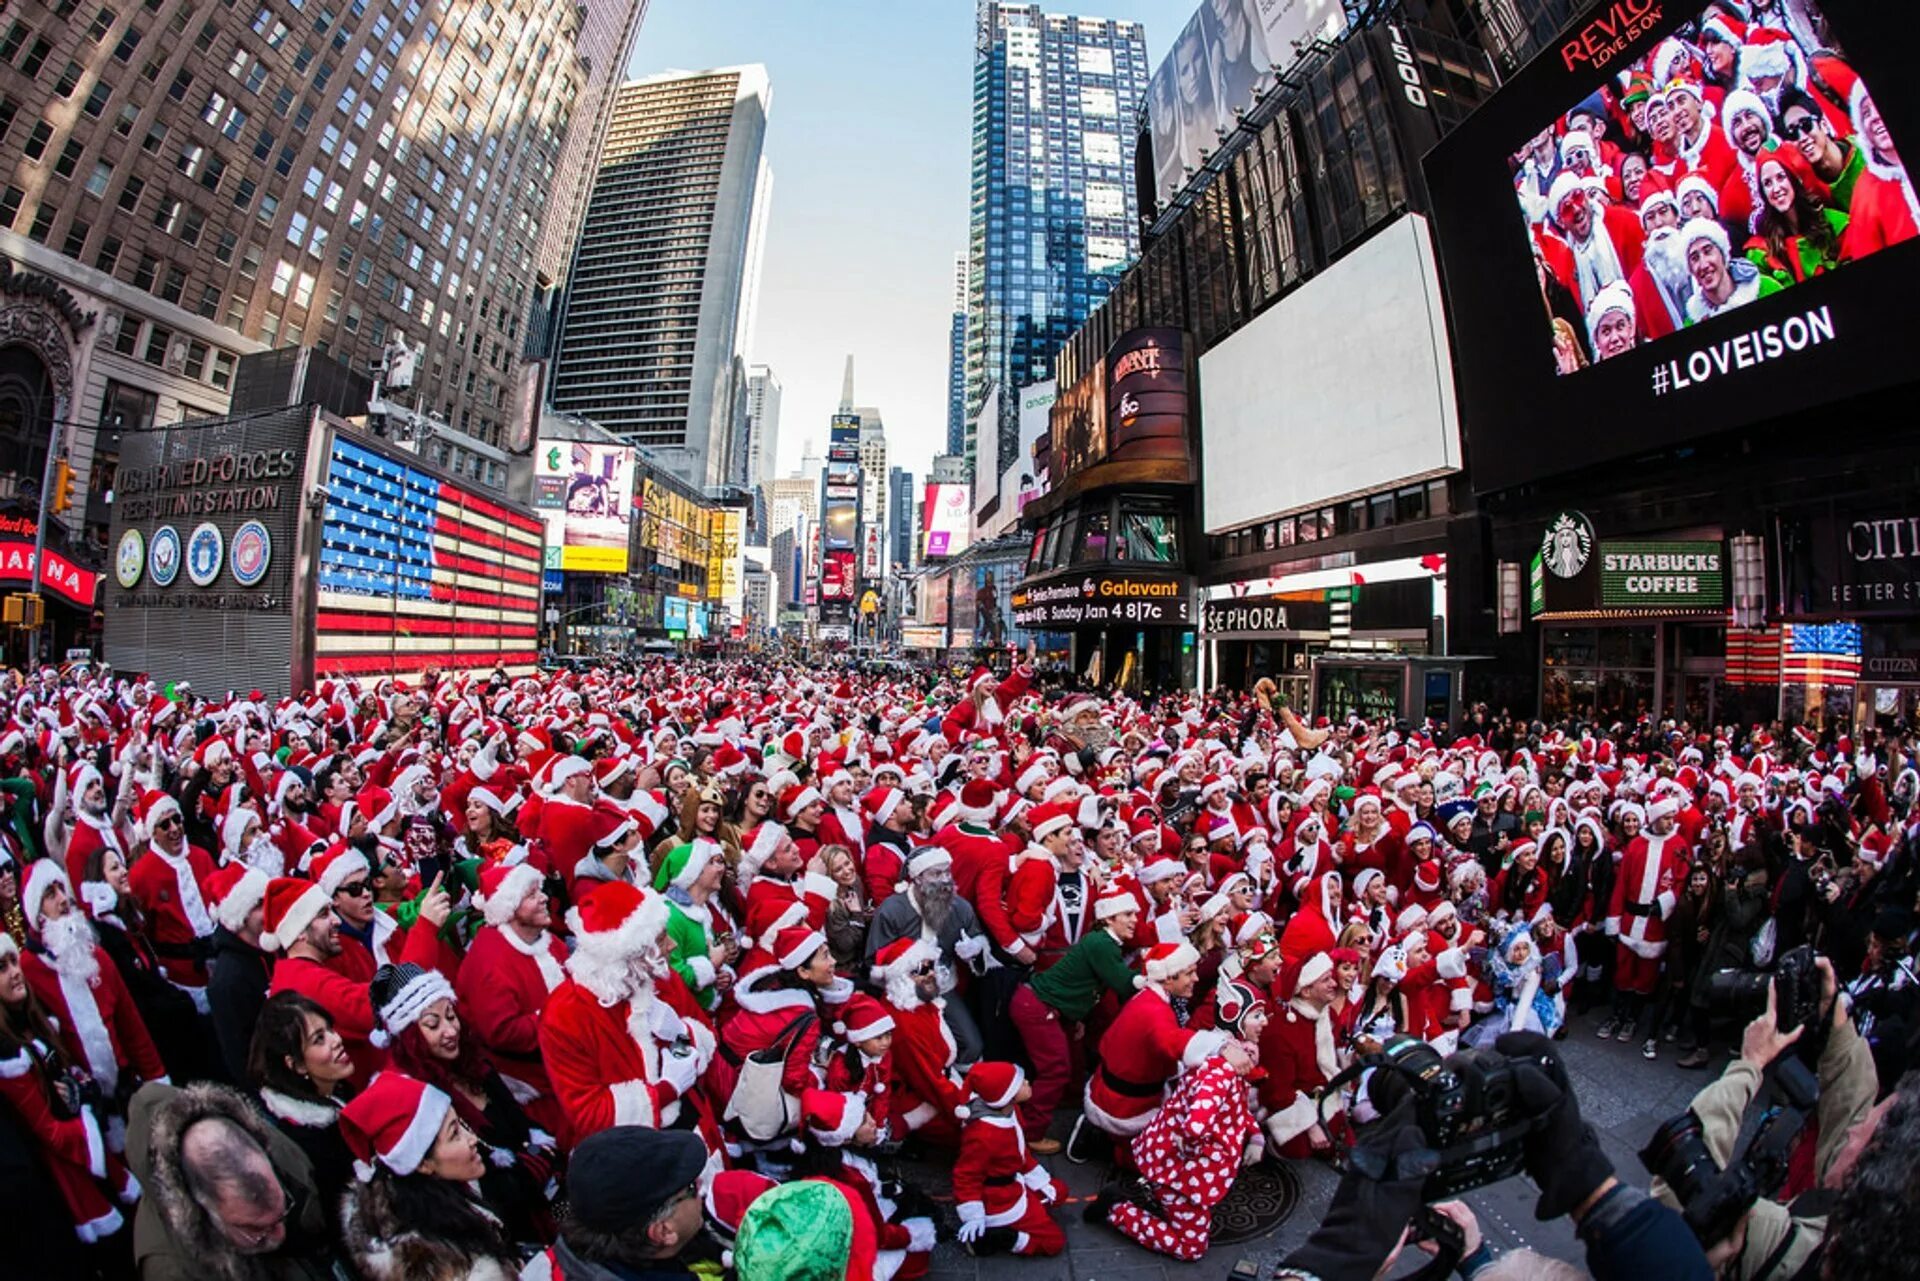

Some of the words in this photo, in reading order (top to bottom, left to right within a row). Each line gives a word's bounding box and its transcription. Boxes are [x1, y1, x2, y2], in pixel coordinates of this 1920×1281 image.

[1592, 36, 1627, 68] LOVE
[1626, 24, 1641, 42] IS
[1640, 5, 1663, 29] ON
[1388, 24, 1427, 107] 1500
[1652, 306, 1835, 395] #LOVEISON
[207, 449, 297, 484] FORCES
[203, 486, 279, 514] STATION
[1605, 554, 1719, 571] STARBUCKS
[1048, 583, 1079, 598] Premiere
[1100, 580, 1179, 596] Galavant
[1626, 576, 1699, 592] COFFEE
[1052, 607, 1083, 622] Sunday
[1085, 604, 1107, 619] Jan
[1111, 603, 1122, 618] 4
[1126, 602, 1162, 622] 8|7c
[1207, 606, 1287, 631] SEPHORA
[1869, 657, 1918, 673] CITIZEN
